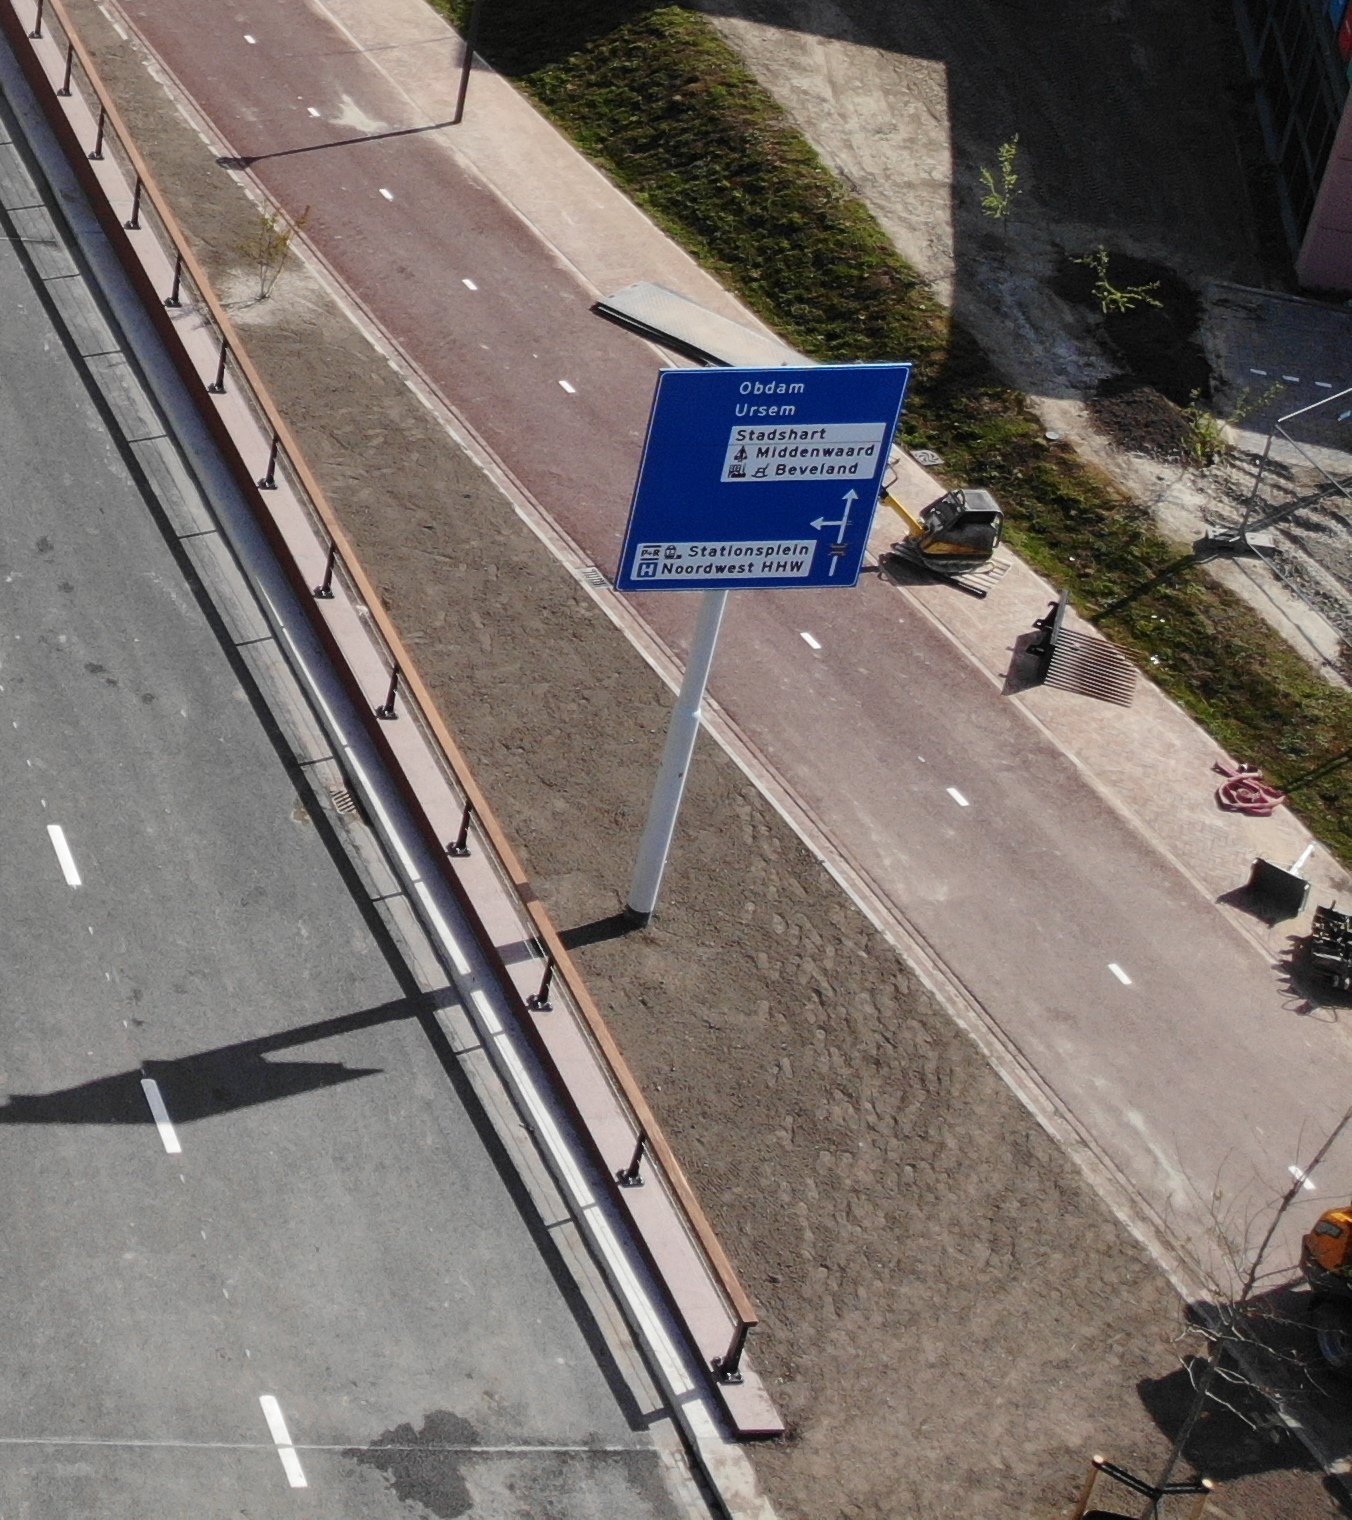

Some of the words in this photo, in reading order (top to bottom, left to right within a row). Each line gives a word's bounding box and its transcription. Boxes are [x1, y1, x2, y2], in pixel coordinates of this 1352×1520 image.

[739, 380, 805, 395] Obdam
[735, 403, 796, 417] Ursem
[735, 428, 826, 442] Stadshart
[755, 444, 875, 459] Middenwaard
[775, 463, 859, 476] Beveland
[687, 543, 810, 559] Stationsplein
[661, 561, 755, 575] Noordwest
[761, 560, 805, 574] HHW
